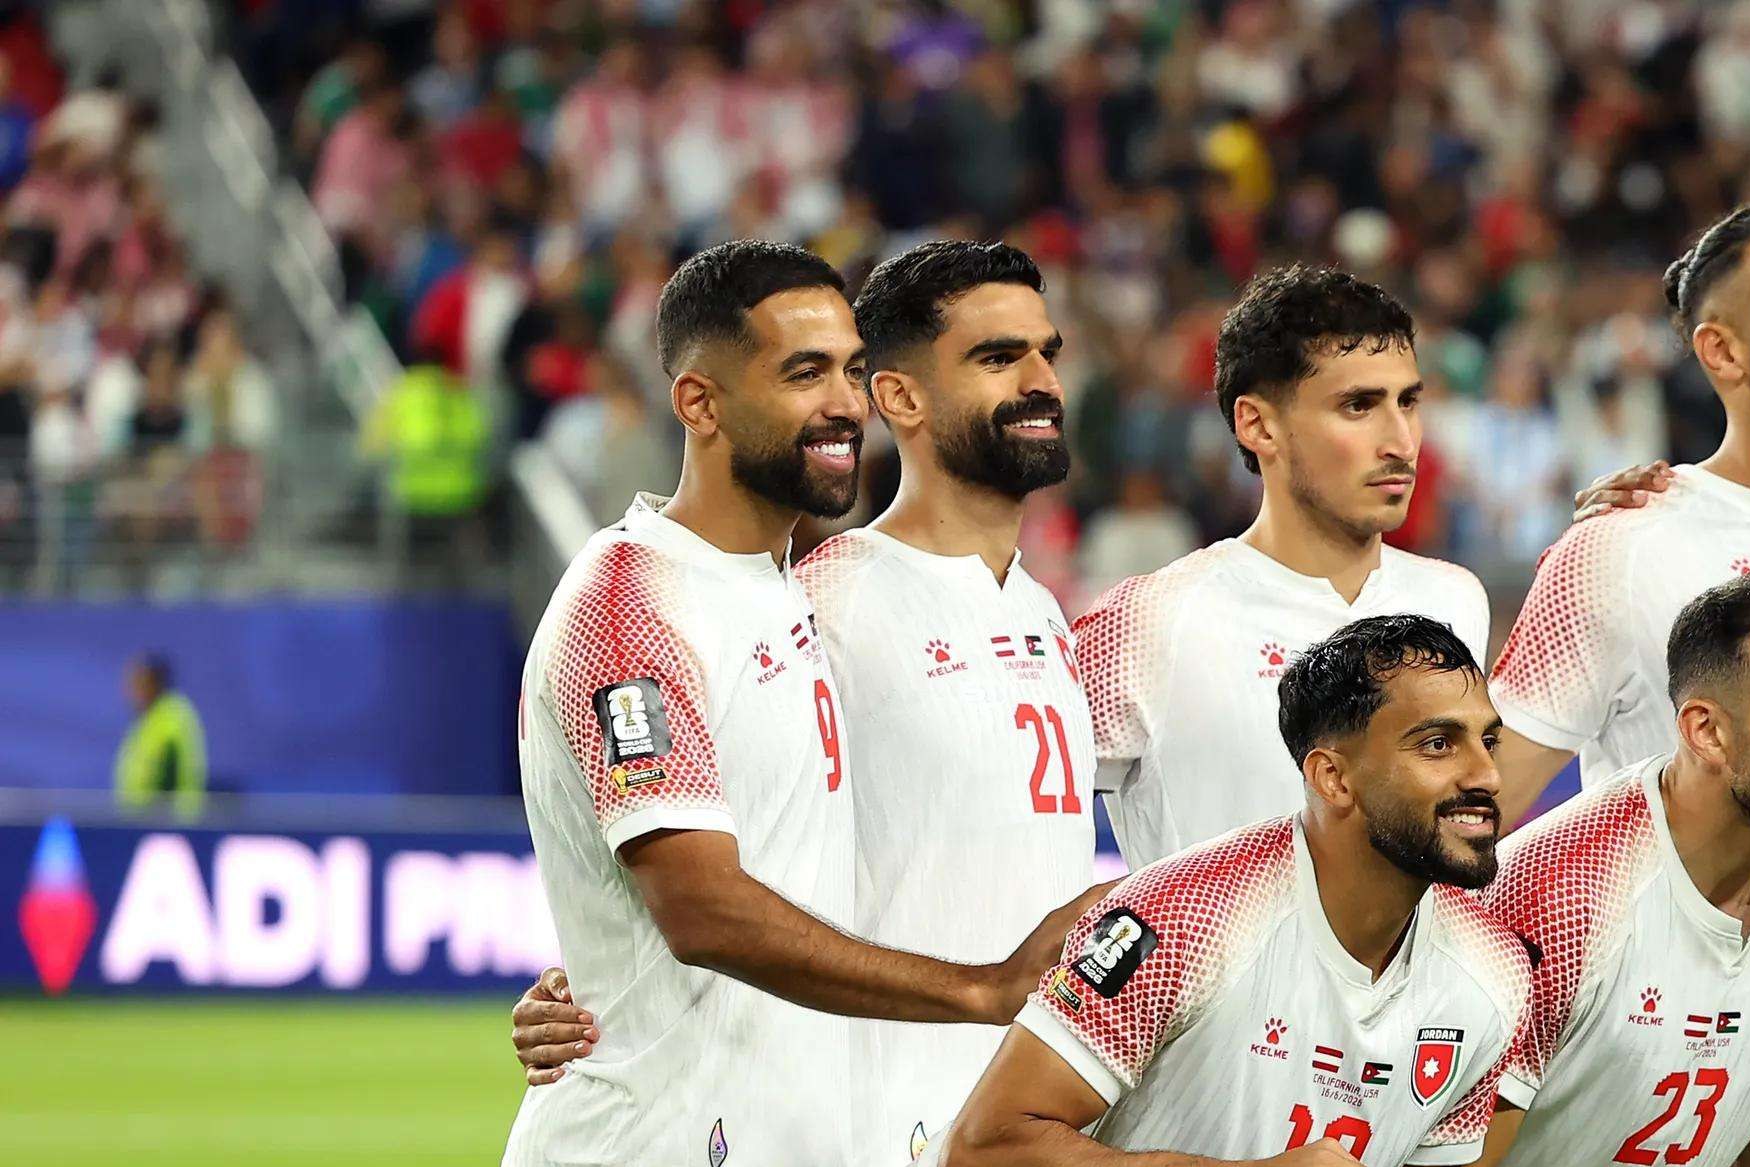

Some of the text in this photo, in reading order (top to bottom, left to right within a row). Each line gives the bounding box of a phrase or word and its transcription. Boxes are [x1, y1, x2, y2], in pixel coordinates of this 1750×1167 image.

[757, 661, 787, 685] KELME
[926, 662, 969, 678] KELME
[1258, 669, 1288, 678] KEL
[814, 679, 841, 792] 9
[1014, 703, 1082, 814] 21
[627, 768, 661, 782] DEBUT
[103, 833, 370, 988] ADI
[1627, 1014, 1664, 1026] KELME
[1419, 1029, 1458, 1041] JORDAN
[1250, 1043, 1289, 1060] KELME
[1312, 1073, 1379, 1098] CALIFORNIA, USA
[1320, 1087, 1363, 1107] 16/6/2026
[1612, 1068, 1729, 1166] 23
